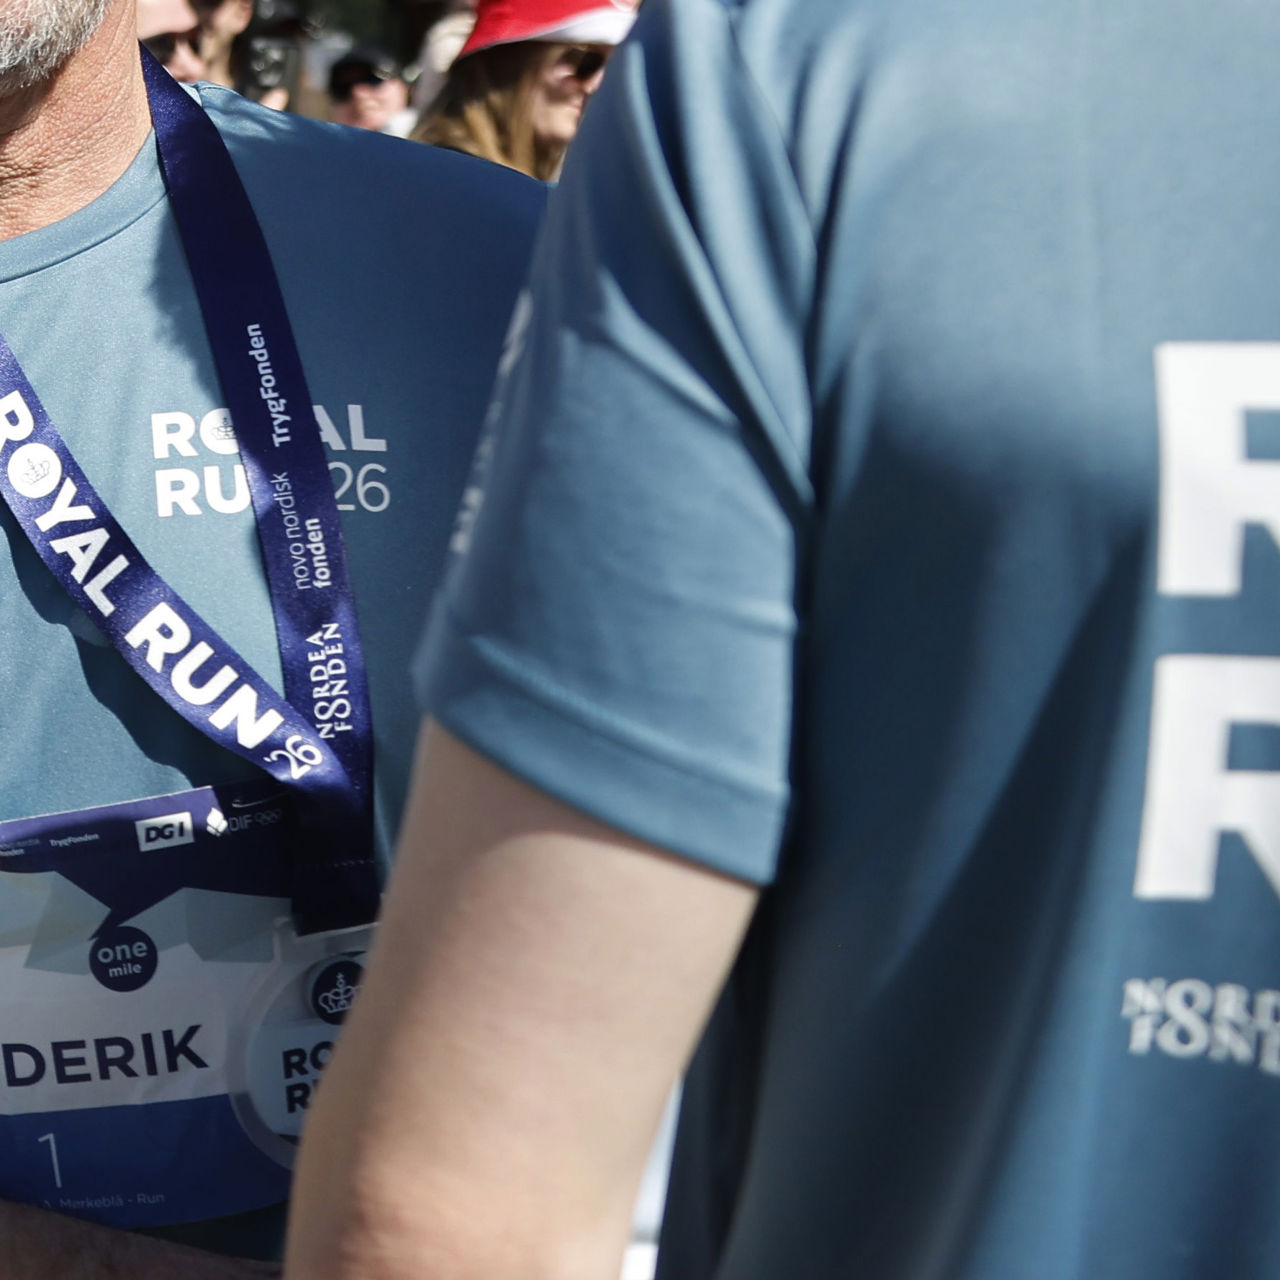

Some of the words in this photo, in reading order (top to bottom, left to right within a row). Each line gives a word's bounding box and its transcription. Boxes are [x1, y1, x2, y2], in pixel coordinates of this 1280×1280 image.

[247, 323, 291, 448] TrygFonden
[151, 404, 388, 459] ROAL
[270, 471, 304, 539] nordisk
[289, 541, 312, 590] novo
[305, 518, 332, 589] fonden
[124, 601, 285, 749] RUN
[305, 631, 336, 738] NORDEA
[321, 622, 354, 732] FONDEN
[143, 821, 186, 843] DGI
[97, 939, 148, 964] one
[108, 963, 142, 978] mile
[38, 1132, 62, 1188] 1
[136, 1193, 165, 1204] Run
